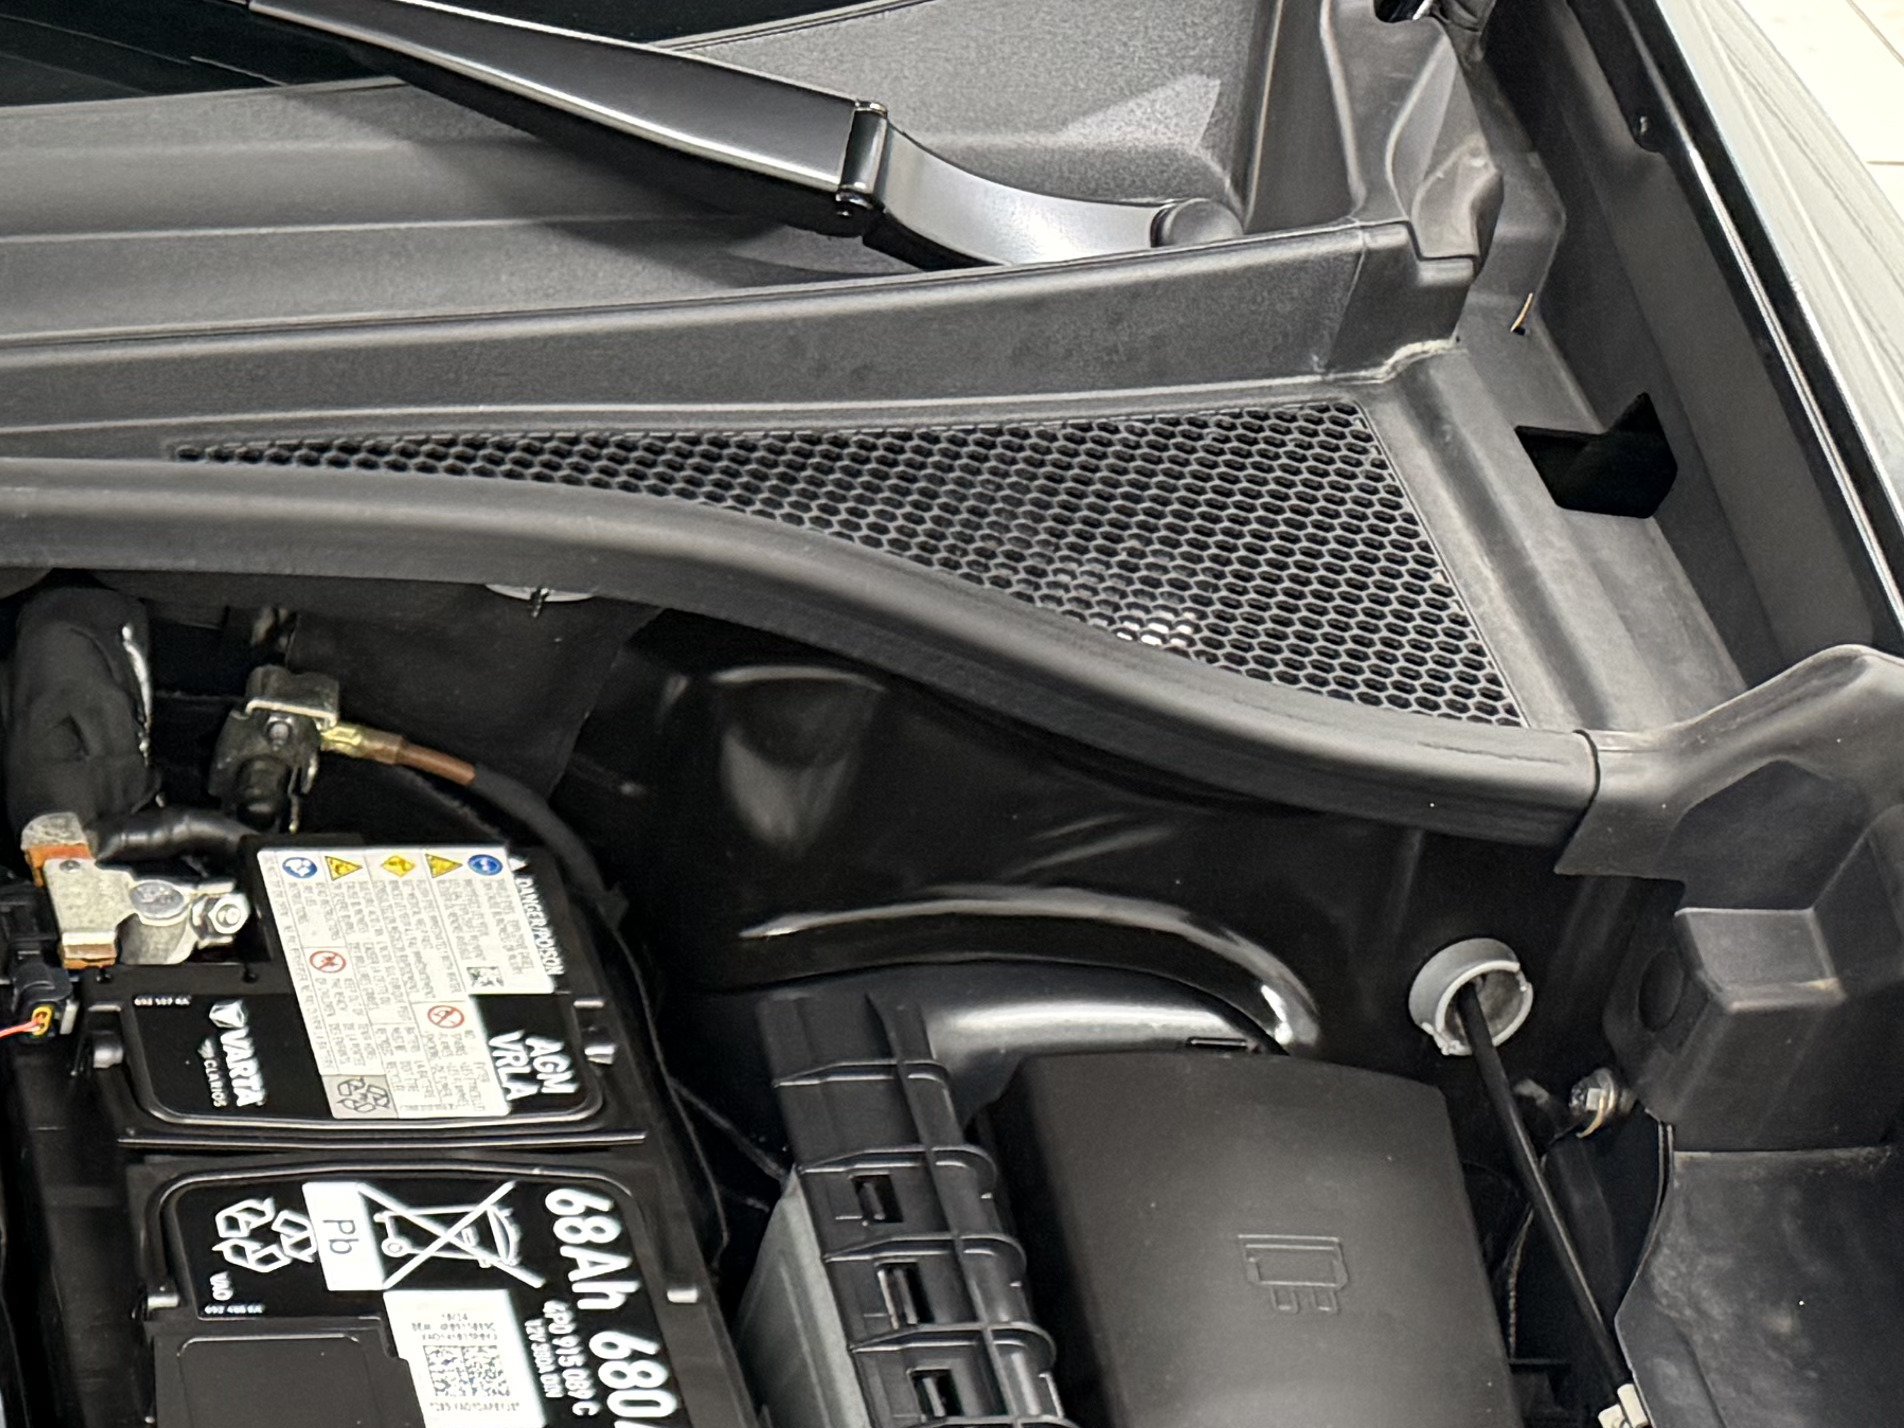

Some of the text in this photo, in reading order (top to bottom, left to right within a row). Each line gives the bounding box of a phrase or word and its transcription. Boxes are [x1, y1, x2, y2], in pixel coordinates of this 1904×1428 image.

[515, 877, 564, 975] DANGER/POISON
[202, 1056, 226, 1107] CLARIOS
[219, 1029, 264, 1106] VARTA
[489, 1030, 538, 1100] VRLA
[525, 1037, 578, 1093] AGM
[321, 1219, 356, 1253] Pb
[545, 1188, 641, 1310] 68Ah
